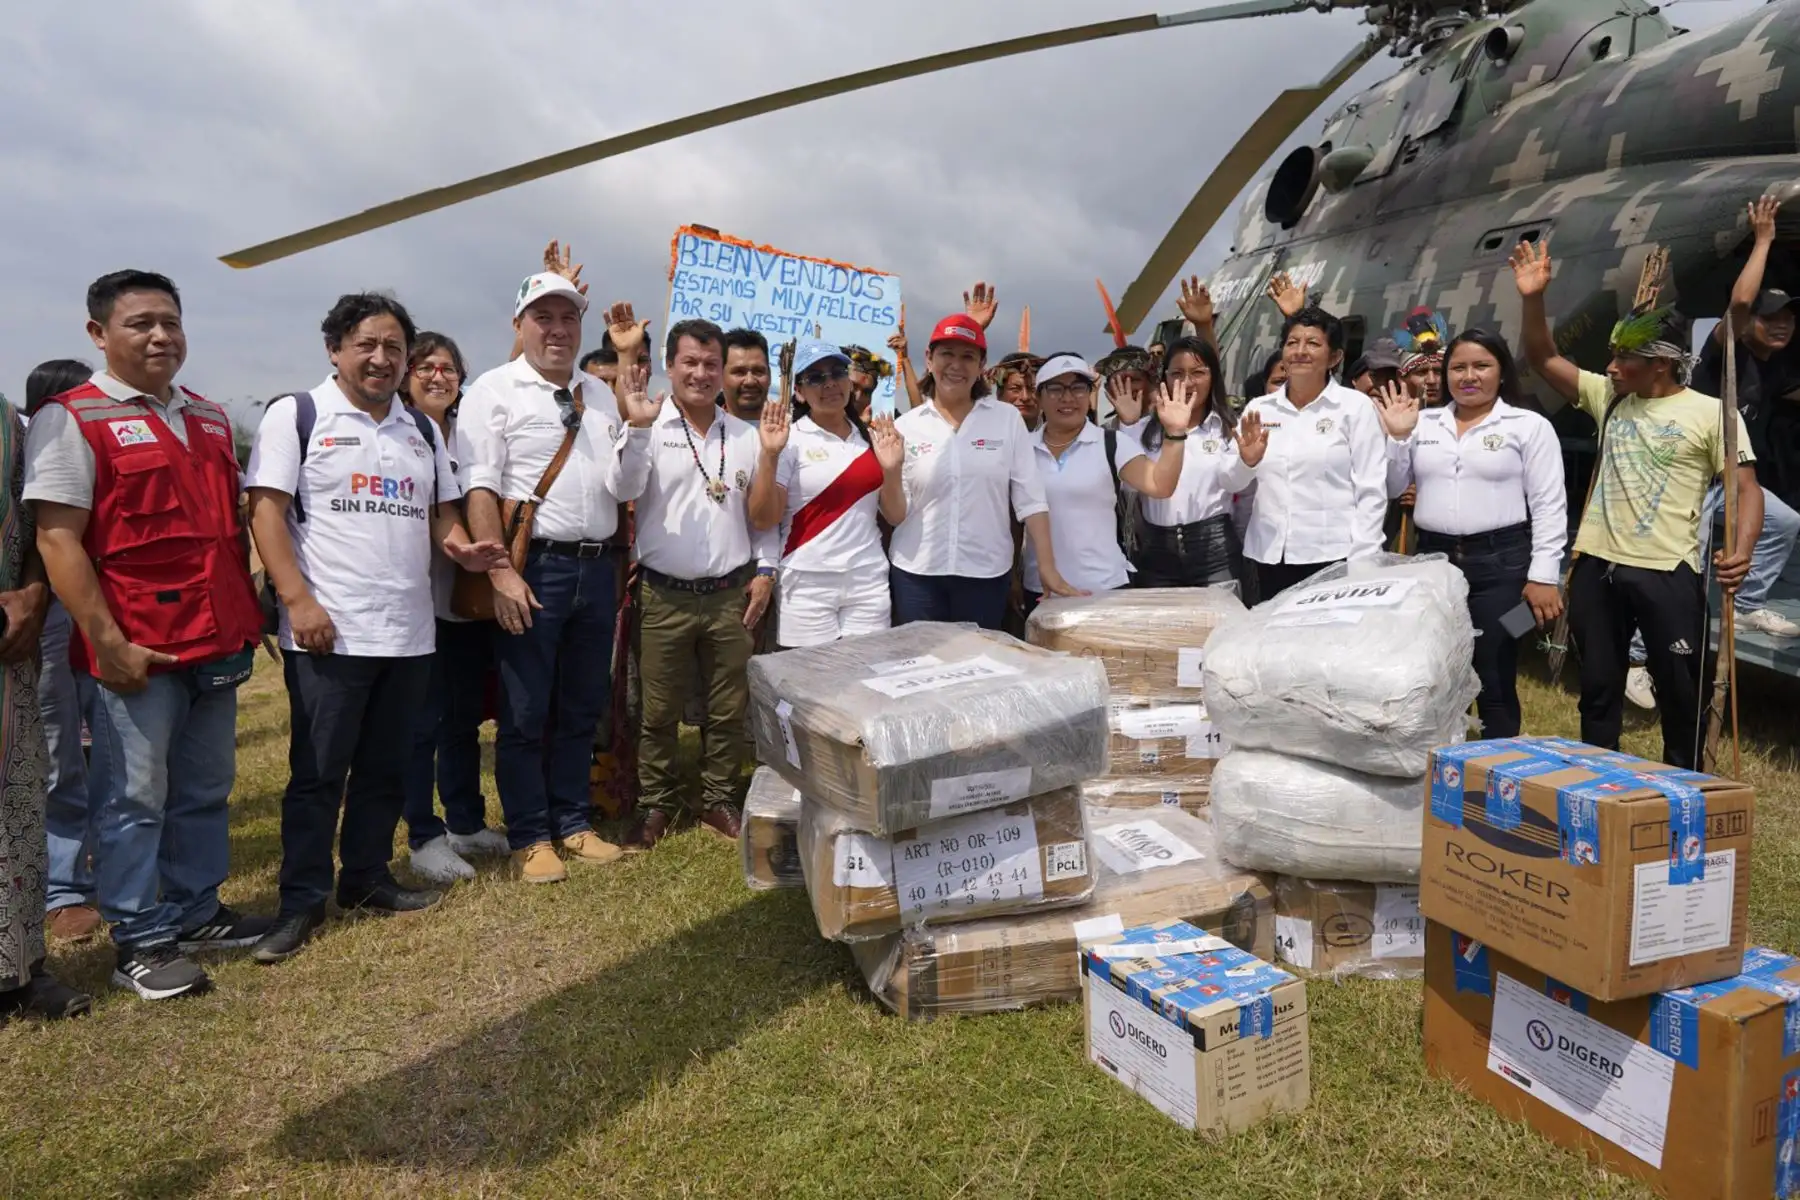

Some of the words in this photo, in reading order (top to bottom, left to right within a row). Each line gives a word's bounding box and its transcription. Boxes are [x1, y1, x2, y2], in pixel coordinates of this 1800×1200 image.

[680, 235, 884, 301] BIENVENIDOS
[673, 270, 756, 299] ESTAMOS
[771, 287, 814, 316] MUY
[816, 296, 896, 327] FELICES
[671, 292, 703, 317] POR
[709, 303, 732, 323] SU
[742, 312, 814, 337] VISITA
[351, 472, 415, 501] PERÚ
[330, 498, 361, 512] SIN
[365, 500, 426, 521] RACISMO
[1205, 732, 1221, 743] 11
[904, 842, 931, 861] ART
[940, 837, 959, 854] NO
[967, 826, 1021, 849] OR-109
[937, 853, 996, 878] (R-010)
[1057, 860, 1077, 871] PCL
[1446, 841, 1571, 905] ROKER
[1704, 854, 1729, 868] RAGIL
[908, 887, 925, 901] 40
[935, 881, 951, 897] 41
[961, 876, 978, 892] 42
[986, 871, 1004, 887] 43
[1011, 866, 1027, 881] 44
[939, 899, 948, 909] 3
[966, 894, 975, 905] 3
[991, 887, 1000, 900] 2
[1383, 919, 1397, 930] 40
[1406, 919, 1421, 930] 41
[1385, 933, 1393, 944] 3
[1410, 933, 1417, 944] 3
[1277, 936, 1294, 949] 14
[1128, 1022, 1167, 1058] DIGERD
[1669, 1001, 1682, 1056] DIGERD
[1558, 1035, 1624, 1080] DIGERD
